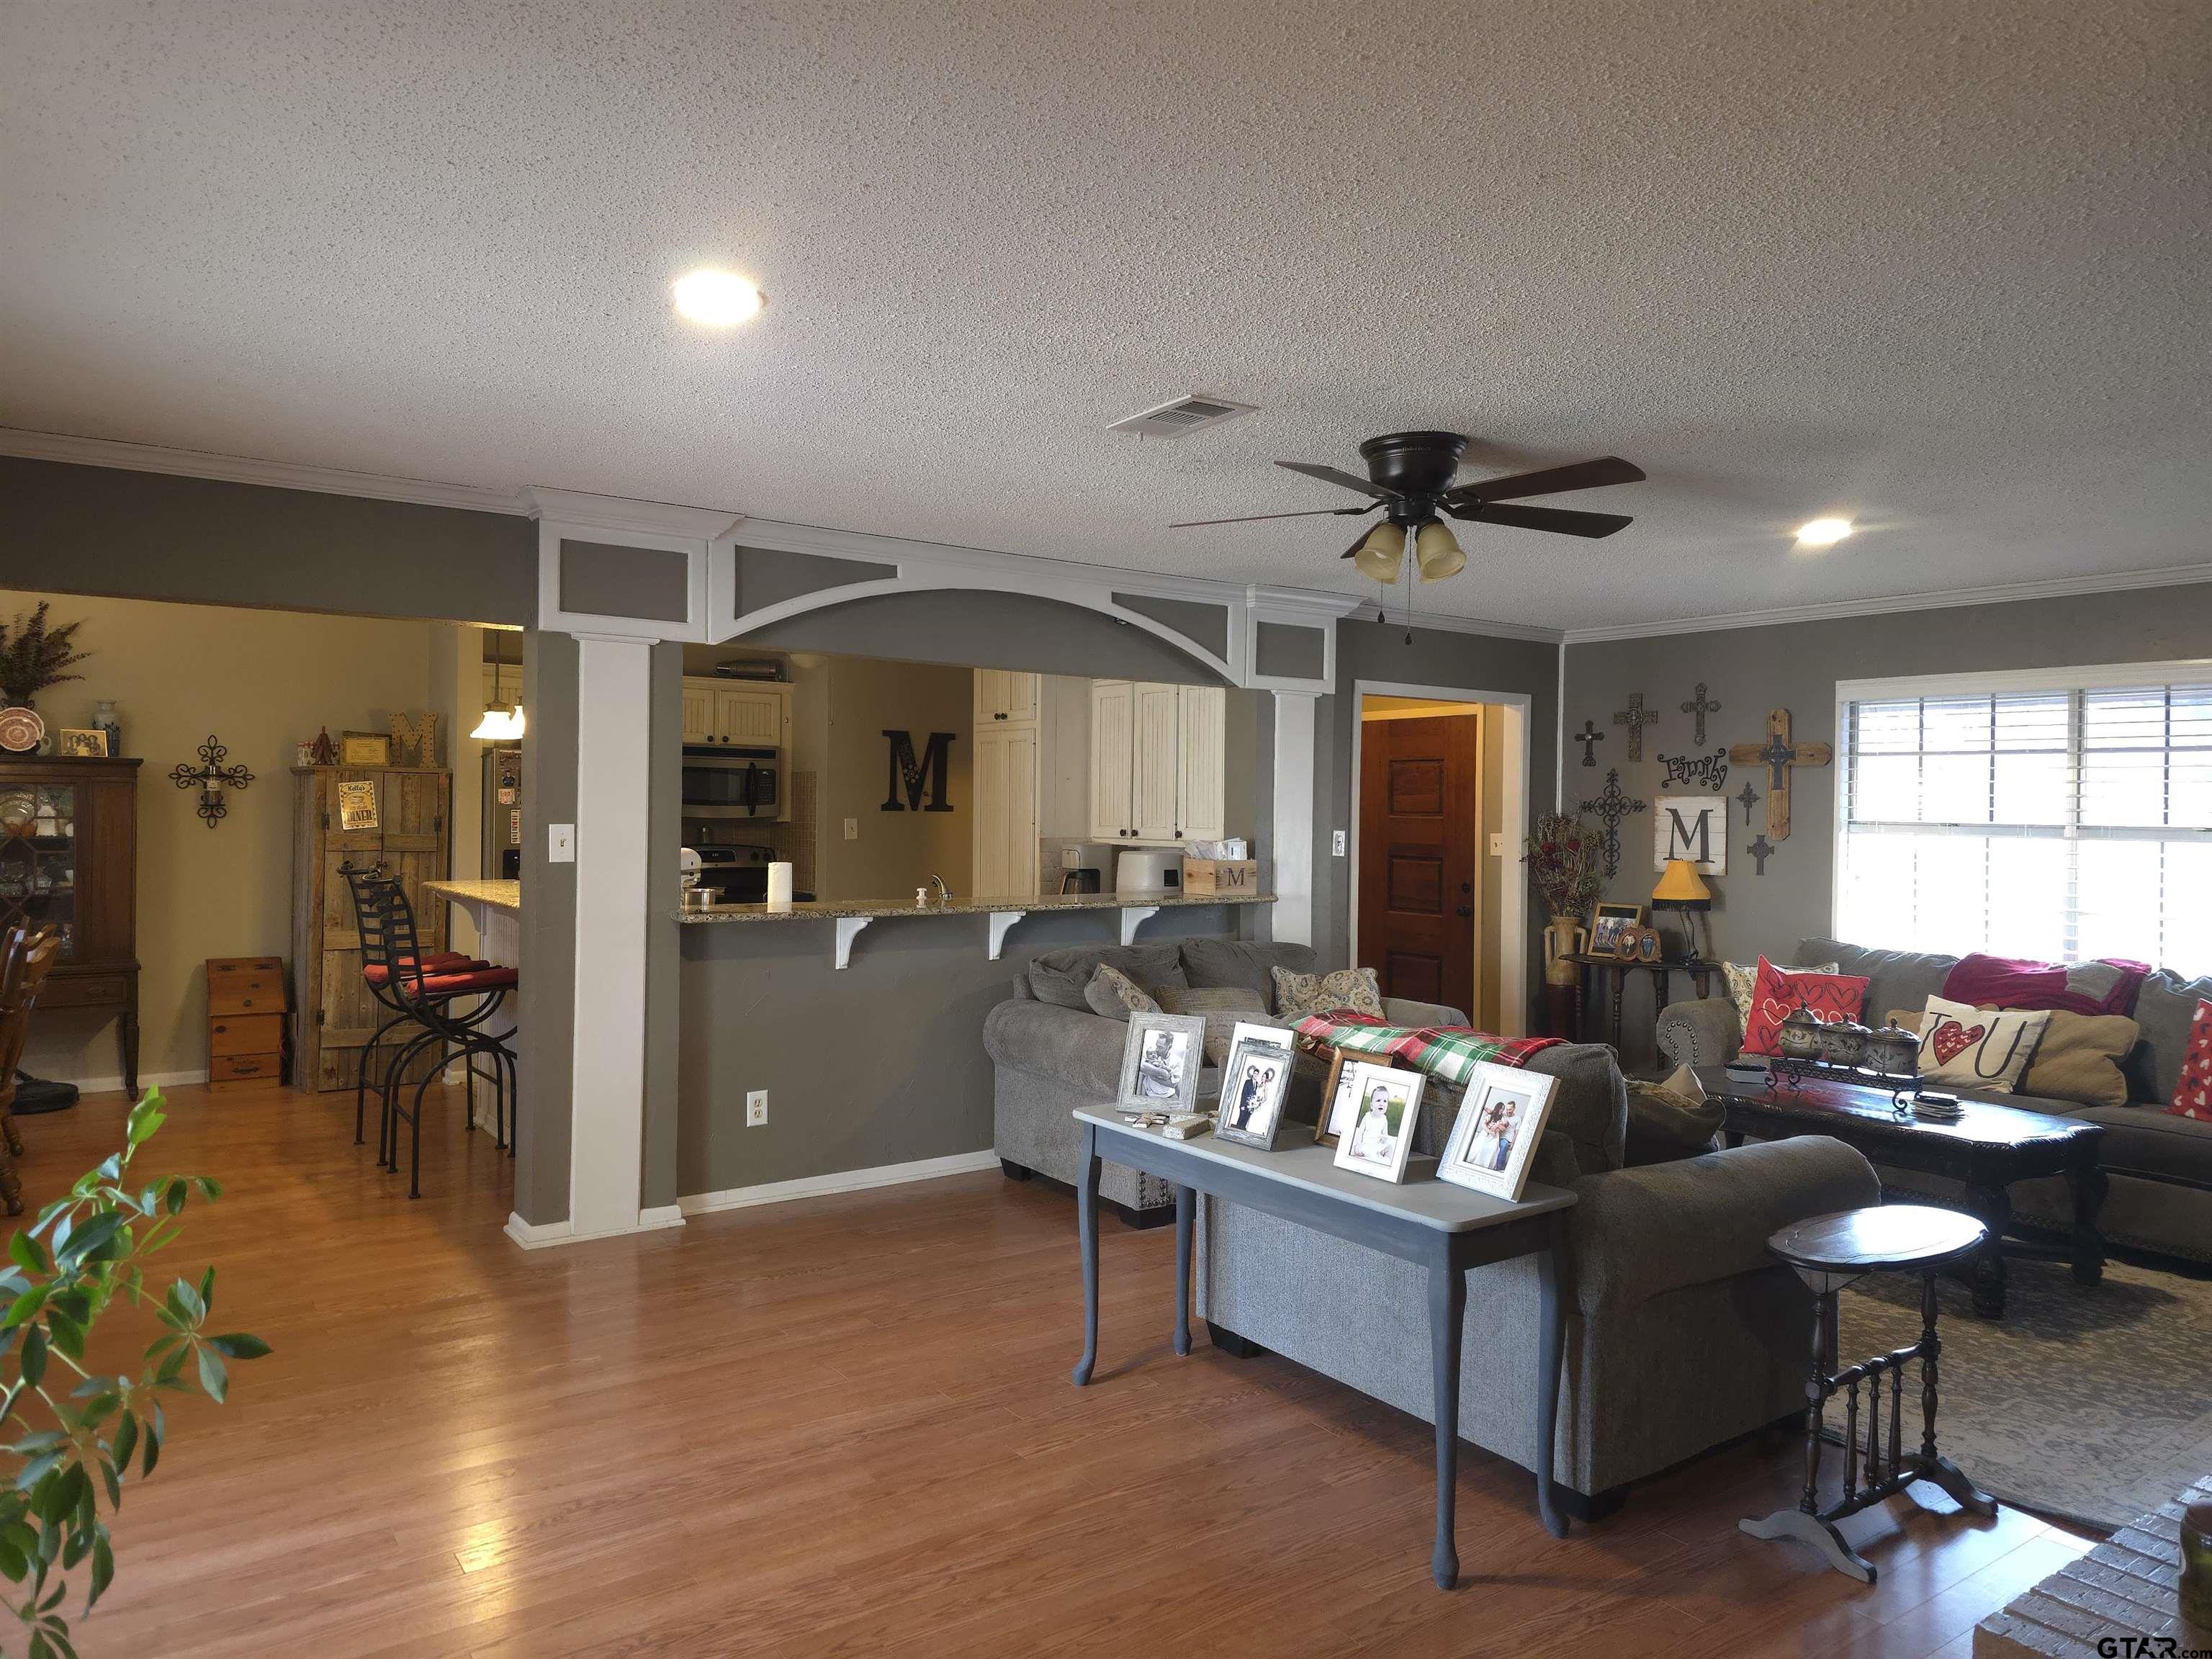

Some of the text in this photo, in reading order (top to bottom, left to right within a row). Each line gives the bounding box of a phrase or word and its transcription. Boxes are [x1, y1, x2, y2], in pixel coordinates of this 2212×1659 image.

[389, 712, 438, 768] M
[881, 730, 956, 811] M
[1658, 748, 1727, 791] Family
[346, 809, 373, 822] DINER
[1663, 808, 1715, 863] M
[1227, 868, 1246, 886] M
[1974, 1017, 2028, 1078] U
